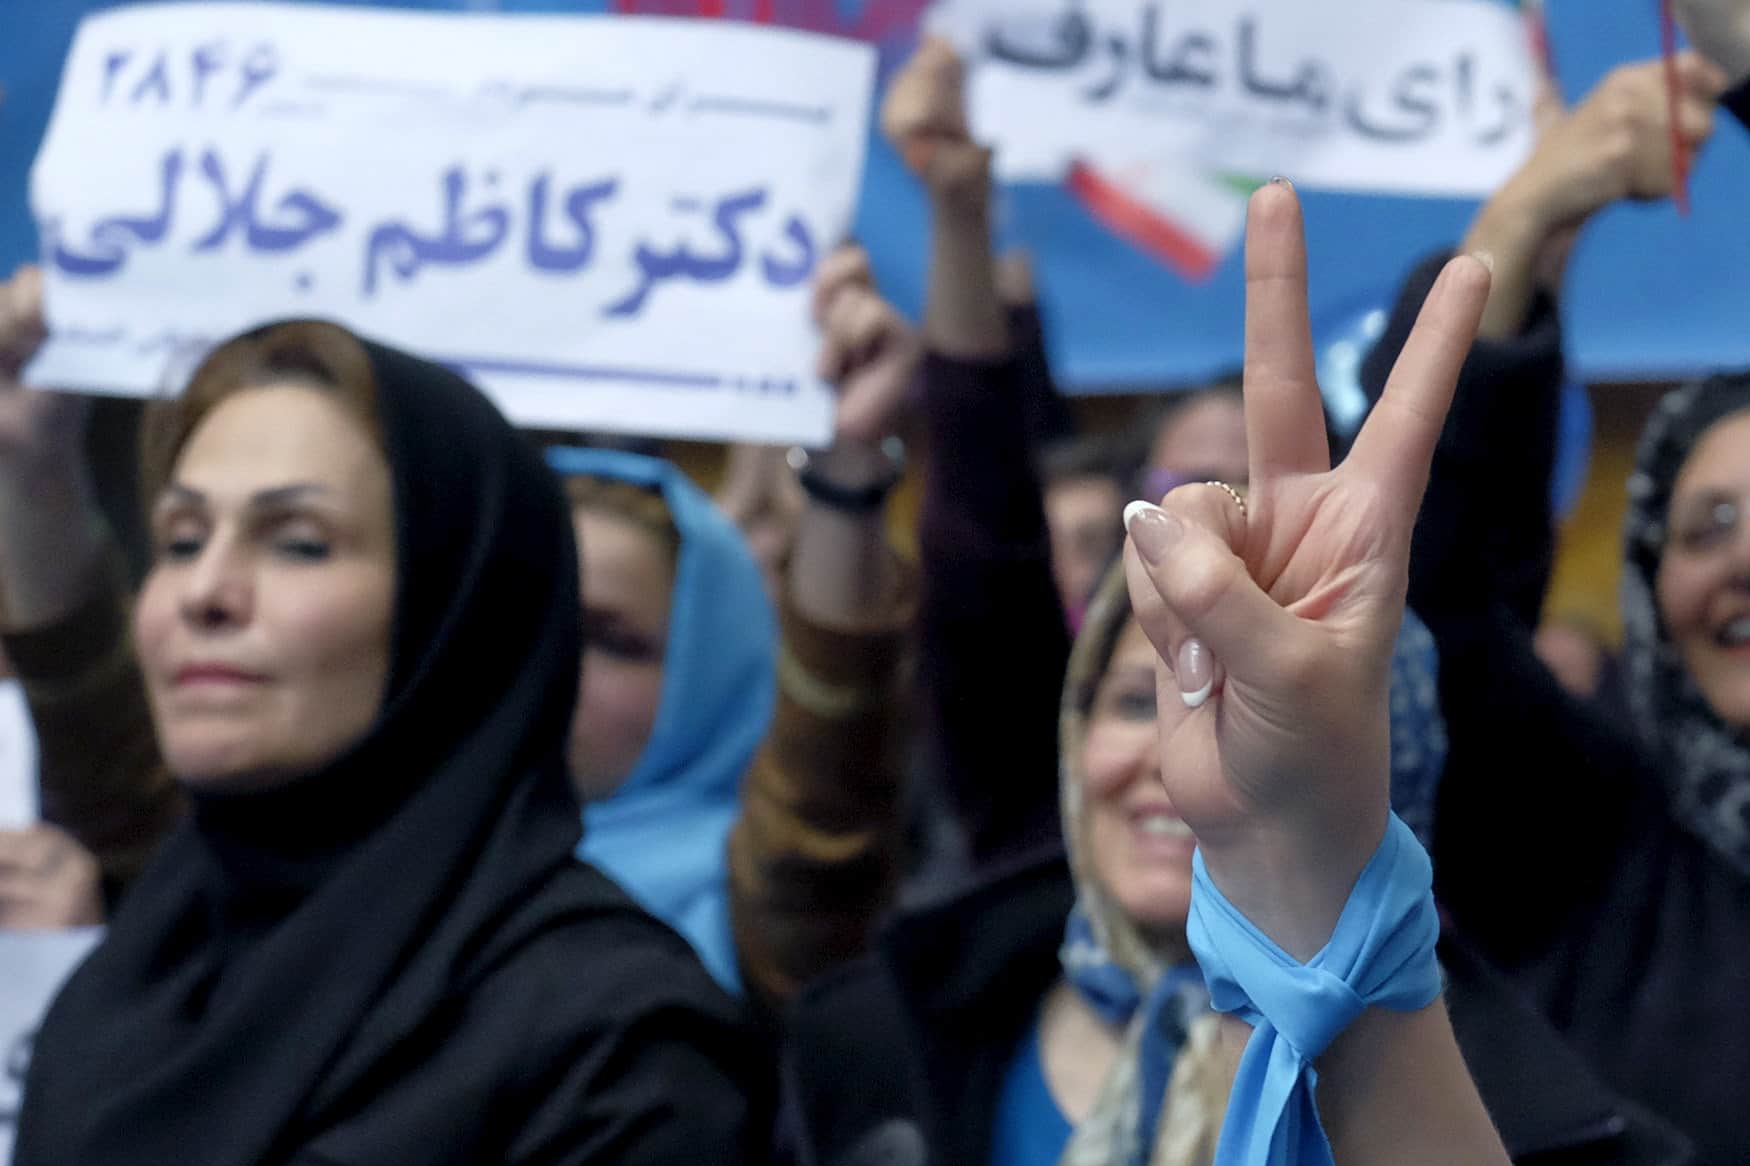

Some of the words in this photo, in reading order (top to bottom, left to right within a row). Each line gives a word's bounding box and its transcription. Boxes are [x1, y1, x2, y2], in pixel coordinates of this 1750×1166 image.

[982, 0, 1219, 102] عارف
[1238, 13, 1327, 112] ما
[1342, 52, 1514, 146] رای
[49, 144, 343, 293] جلالی
[362, 164, 622, 296] کاظم
[601, 186, 818, 318] دکتر
